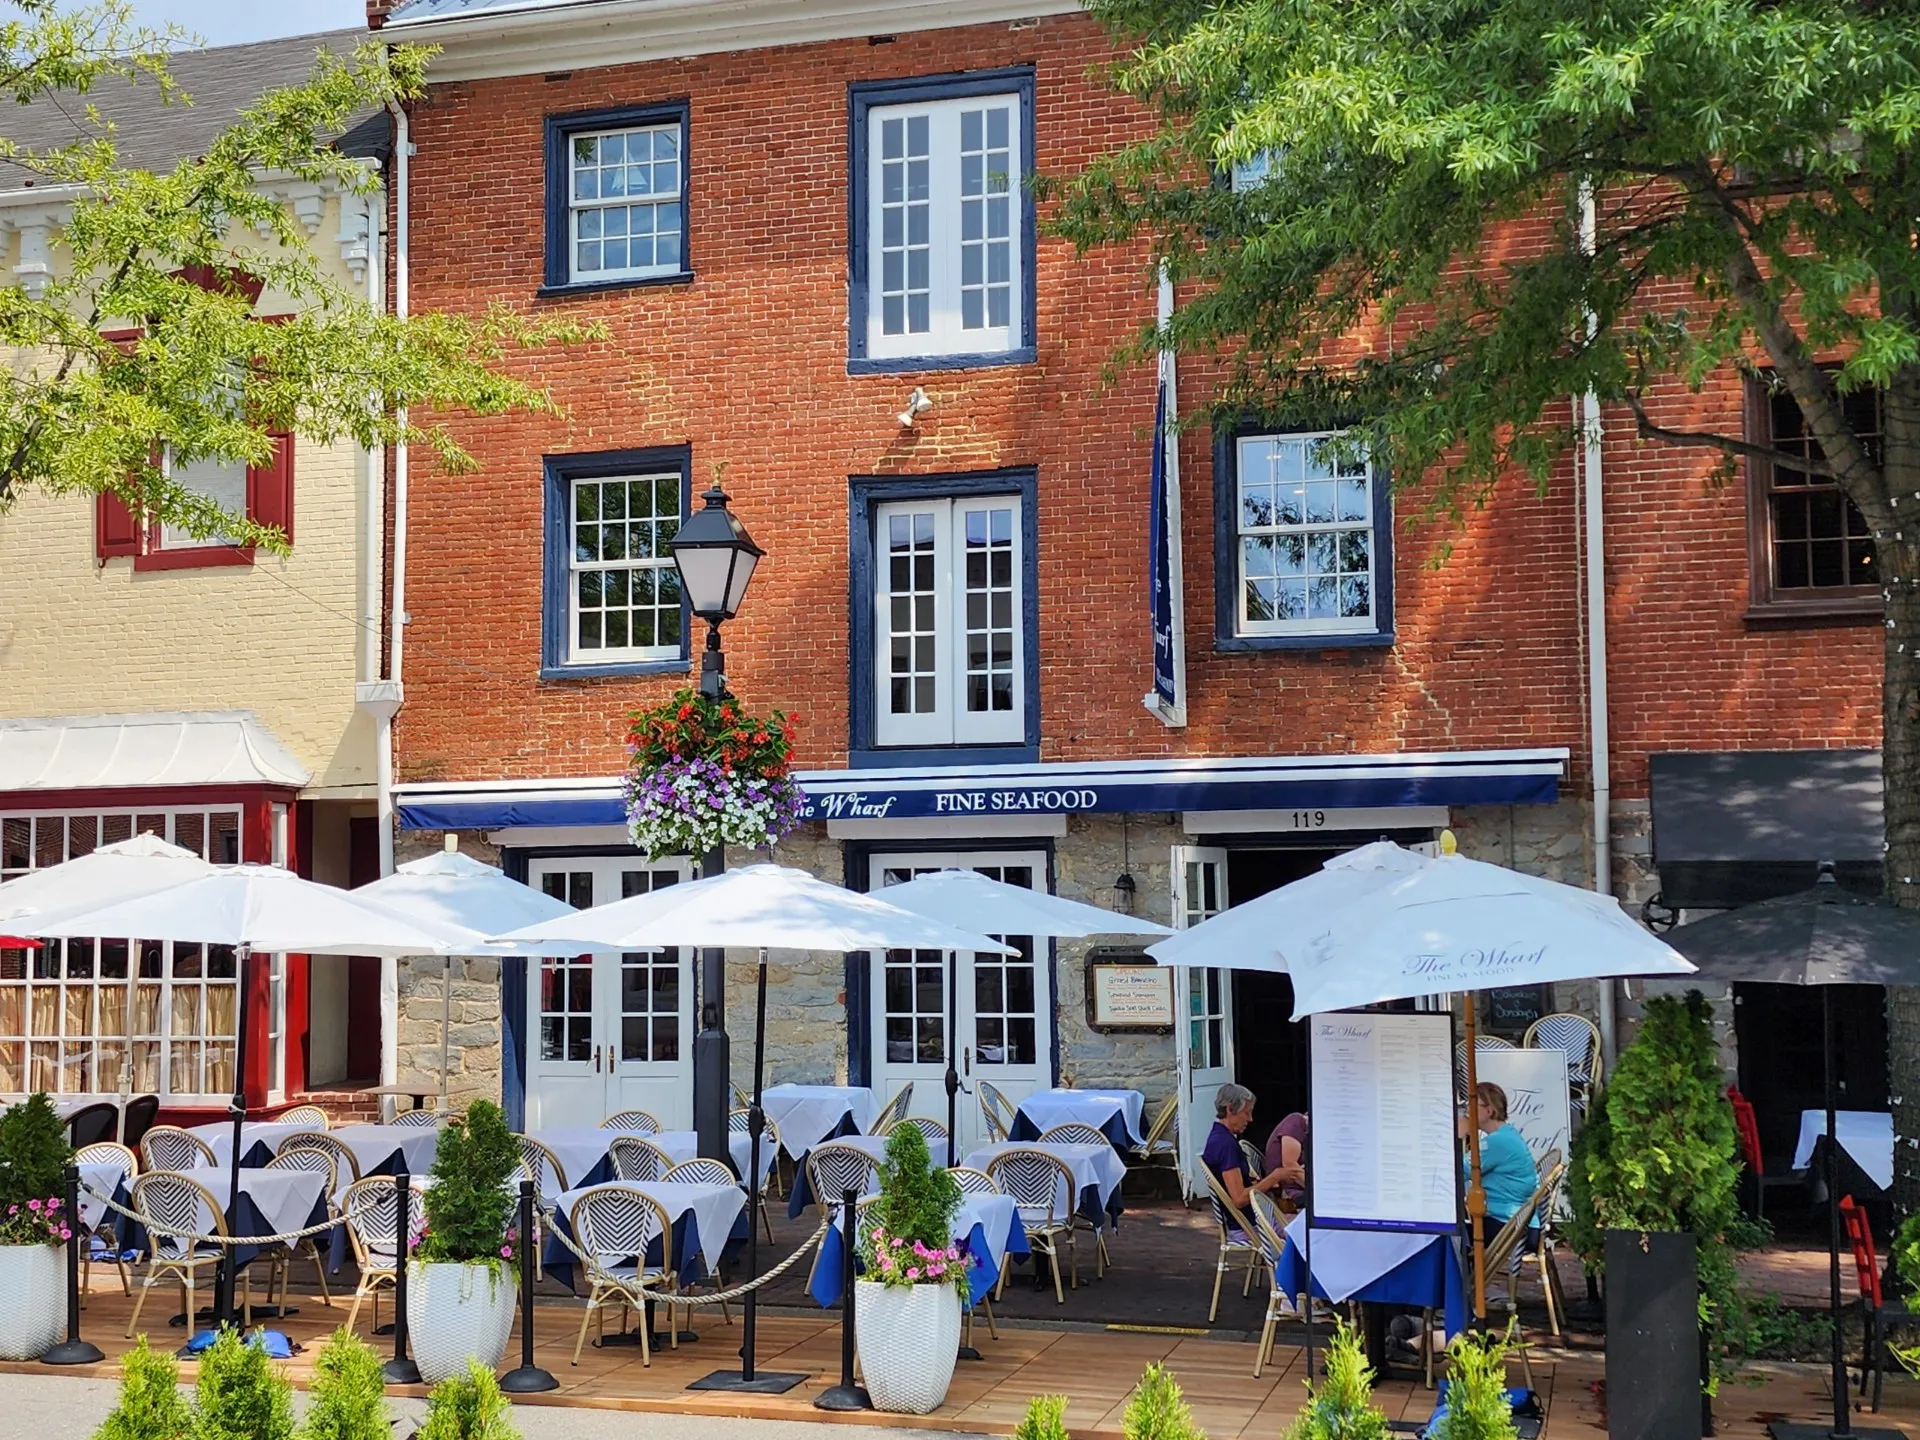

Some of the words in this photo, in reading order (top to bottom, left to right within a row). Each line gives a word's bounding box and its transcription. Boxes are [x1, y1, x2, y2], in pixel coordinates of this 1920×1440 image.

[820, 792, 897, 818] Wharf
[935, 793, 986, 811] FINE
[991, 790, 1097, 810] SEAFOOD
[1292, 811, 1325, 828] 119
[1402, 953, 1449, 976] The
[1460, 941, 1549, 969] Wharf
[1457, 967, 1514, 979] SEAFOOD
[1315, 1024, 1336, 1036] The
[1338, 1024, 1372, 1039] Wharf
[1506, 1087, 1545, 1115] The
